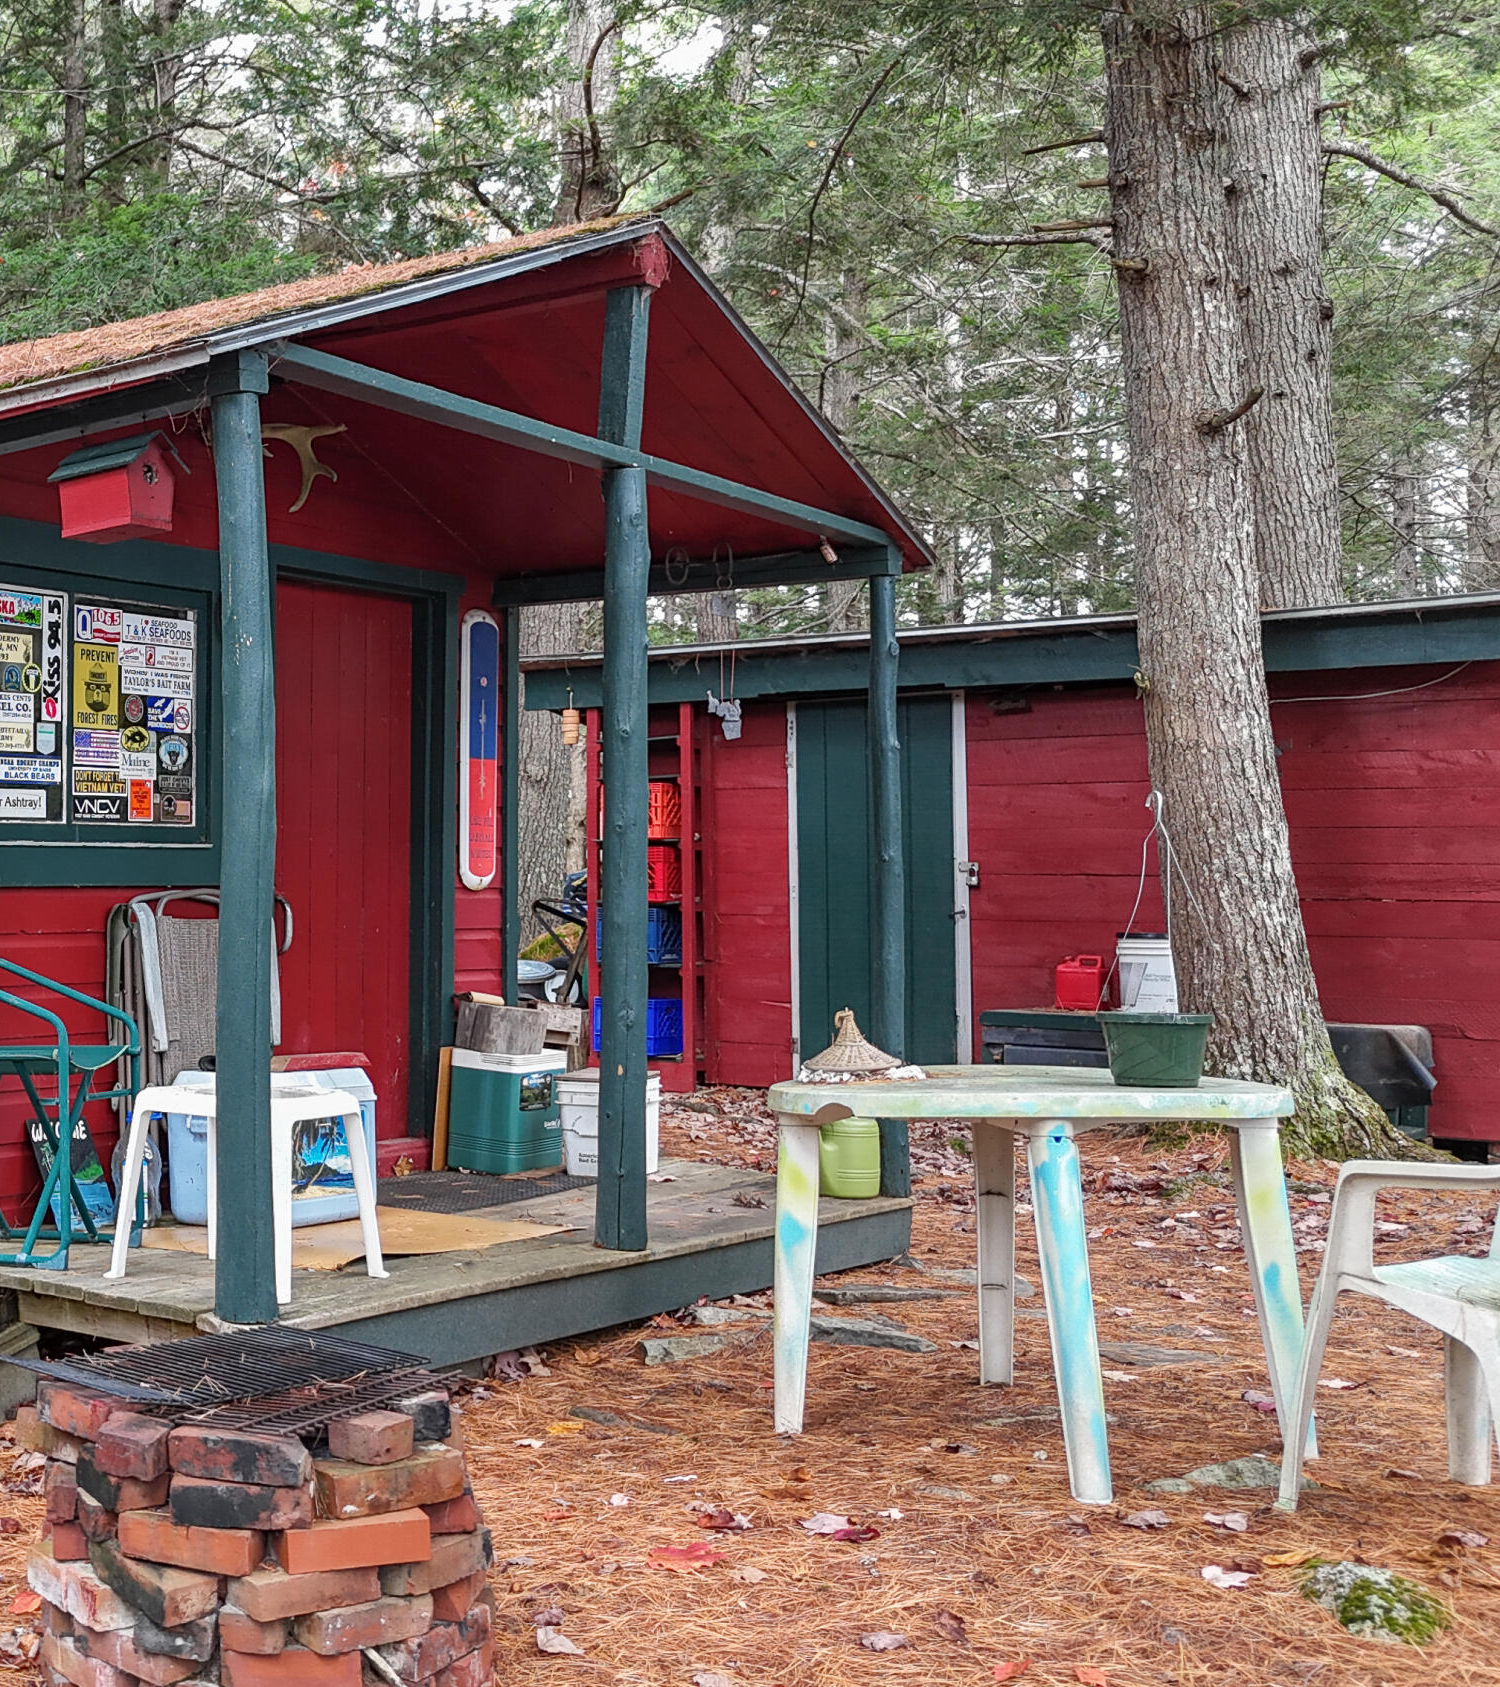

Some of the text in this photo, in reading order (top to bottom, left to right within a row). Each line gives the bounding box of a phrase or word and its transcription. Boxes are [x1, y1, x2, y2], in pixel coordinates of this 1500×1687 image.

[77, 609, 120, 640] Q 106.5
[151, 620, 178, 629] SEAFOOD
[126, 624, 132, 635] T
[134, 625, 139, 635] &
[141, 626, 147, 636] K
[149, 627, 192, 642] SEAFOODS
[6, 643, 19, 652] MN
[43, 599, 61, 704] Kiss 94.5
[80, 648, 115, 664] PREVENT
[124, 675, 191, 691] TAYLOR'S BAIT FARM
[15, 703, 32, 713] CO.
[77, 711, 118, 726] FOREST FIRES
[121, 753, 150, 768] Maine
[4, 771, 56, 780] BLACK BEARS
[75, 770, 92, 781] DON'T
[75, 782, 108, 793] VIETNAM
[4, 796, 42, 810] Ashtray!
[74, 799, 120, 814] VNCV
